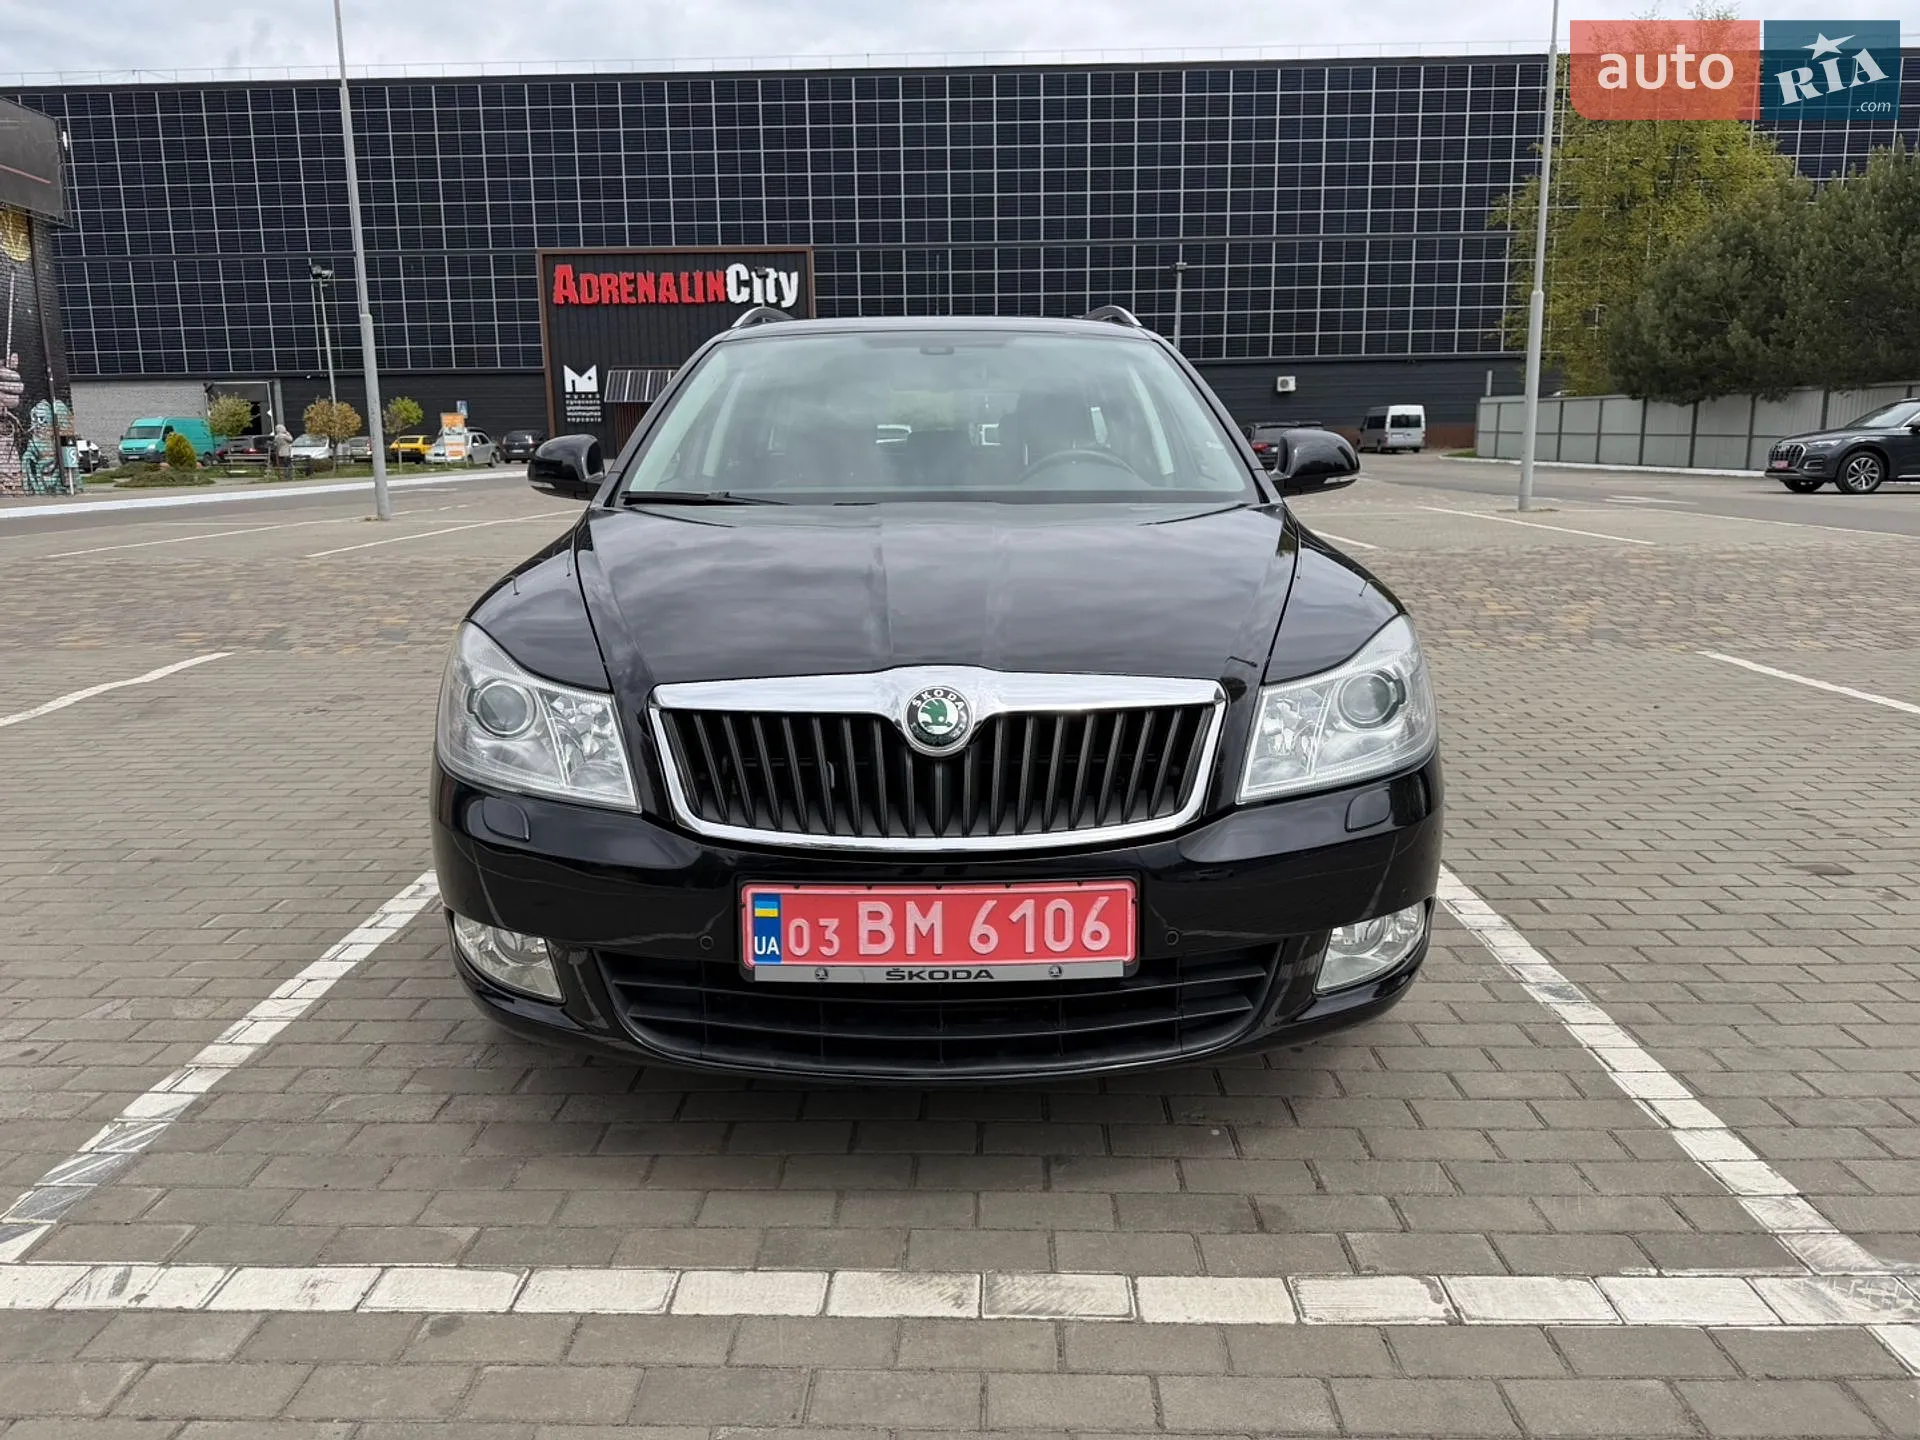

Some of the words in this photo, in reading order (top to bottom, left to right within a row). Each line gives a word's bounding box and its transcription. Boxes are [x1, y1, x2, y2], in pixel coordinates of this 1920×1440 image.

[754, 935, 780, 955] UA
[788, 917, 840, 956] 03
[857, 900, 943, 955] BM
[969, 896, 1112, 954] 6106
